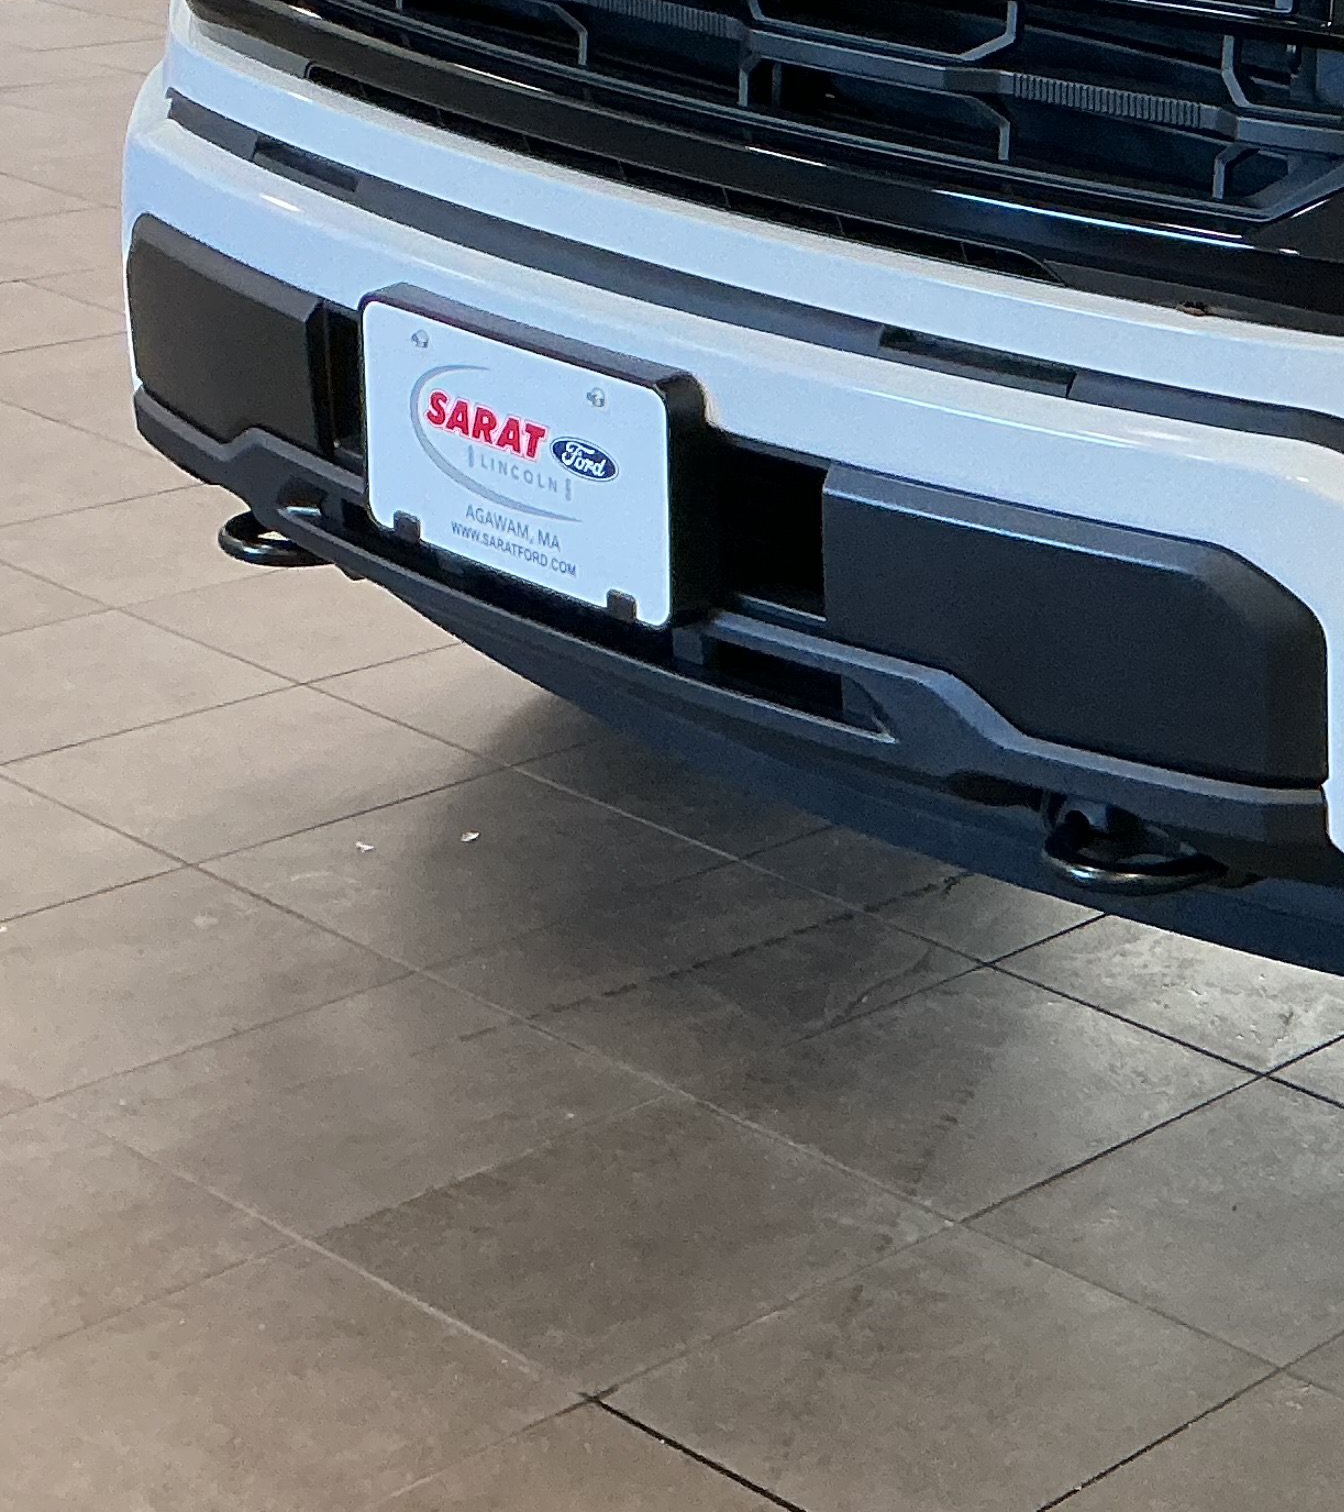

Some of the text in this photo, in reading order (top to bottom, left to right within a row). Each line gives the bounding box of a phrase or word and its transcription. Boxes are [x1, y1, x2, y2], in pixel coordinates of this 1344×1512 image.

[425, 390, 607, 478] SARAT Ford
[480, 453, 558, 494] LINCOLN
[450, 520, 577, 577] WWW.SARATFORDCOM
[465, 504, 561, 551] AGAWAM, MA
